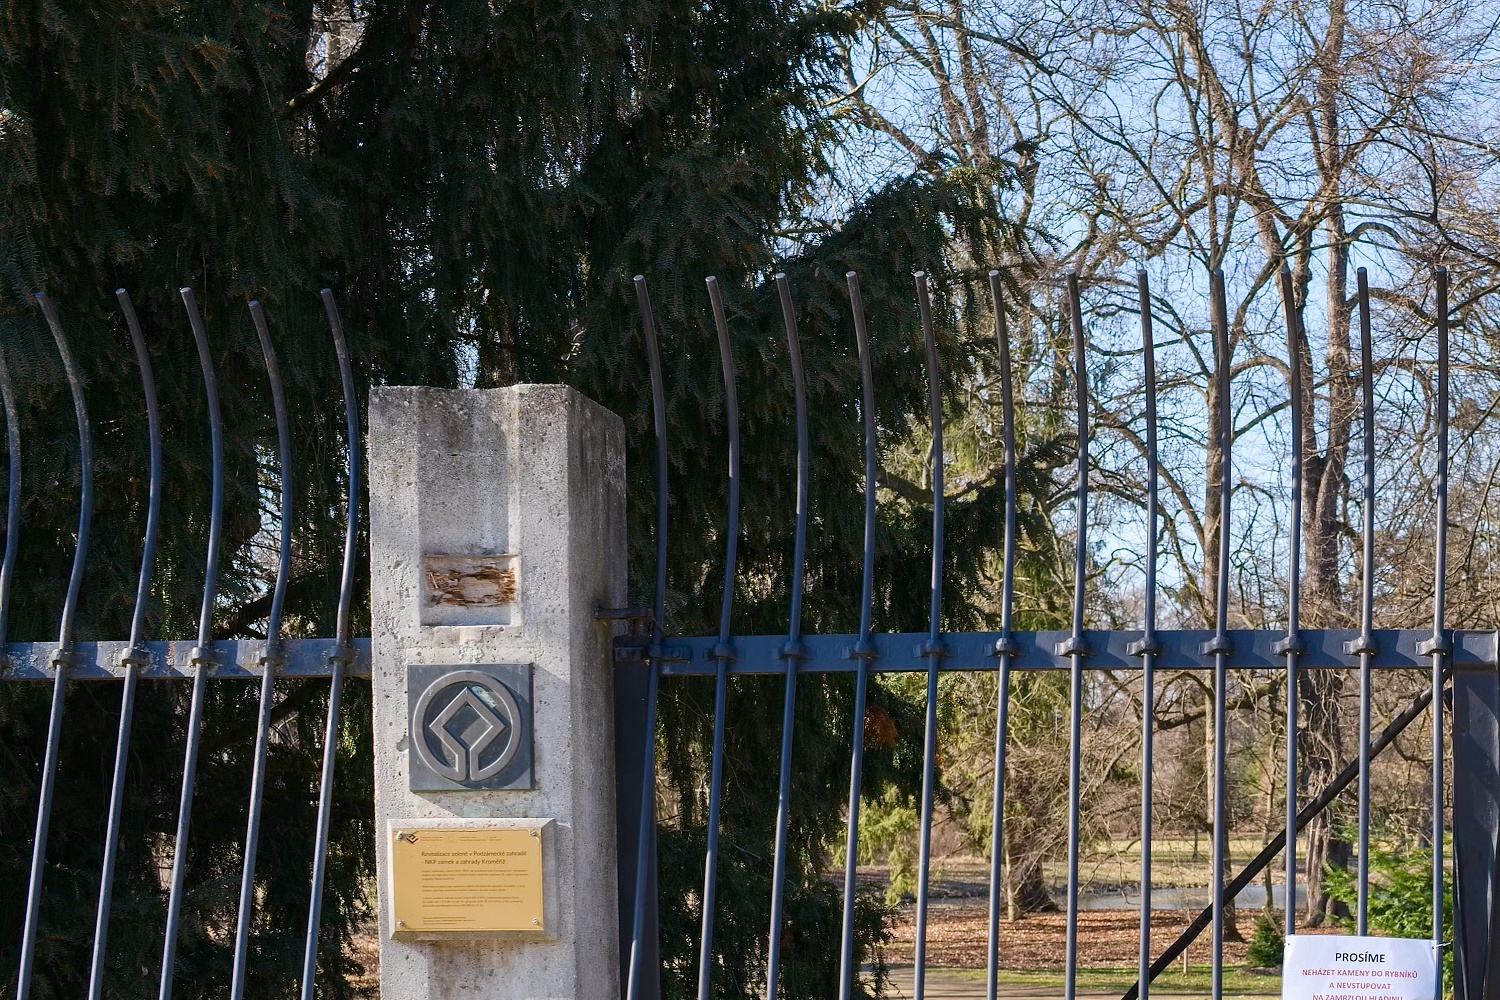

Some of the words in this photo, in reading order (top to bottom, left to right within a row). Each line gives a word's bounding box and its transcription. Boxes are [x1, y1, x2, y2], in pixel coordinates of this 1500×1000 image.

[1335, 951, 1386, 963] PROSÍME
[1302, 968, 1335, 976] NEHÁZET
[1337, 969, 1369, 977] KAMENY
[1371, 970, 1383, 978] DO
[1385, 969, 1418, 979] RYBNÍKŮ
[1336, 982, 1391, 990] NEVSTUPOVAT
